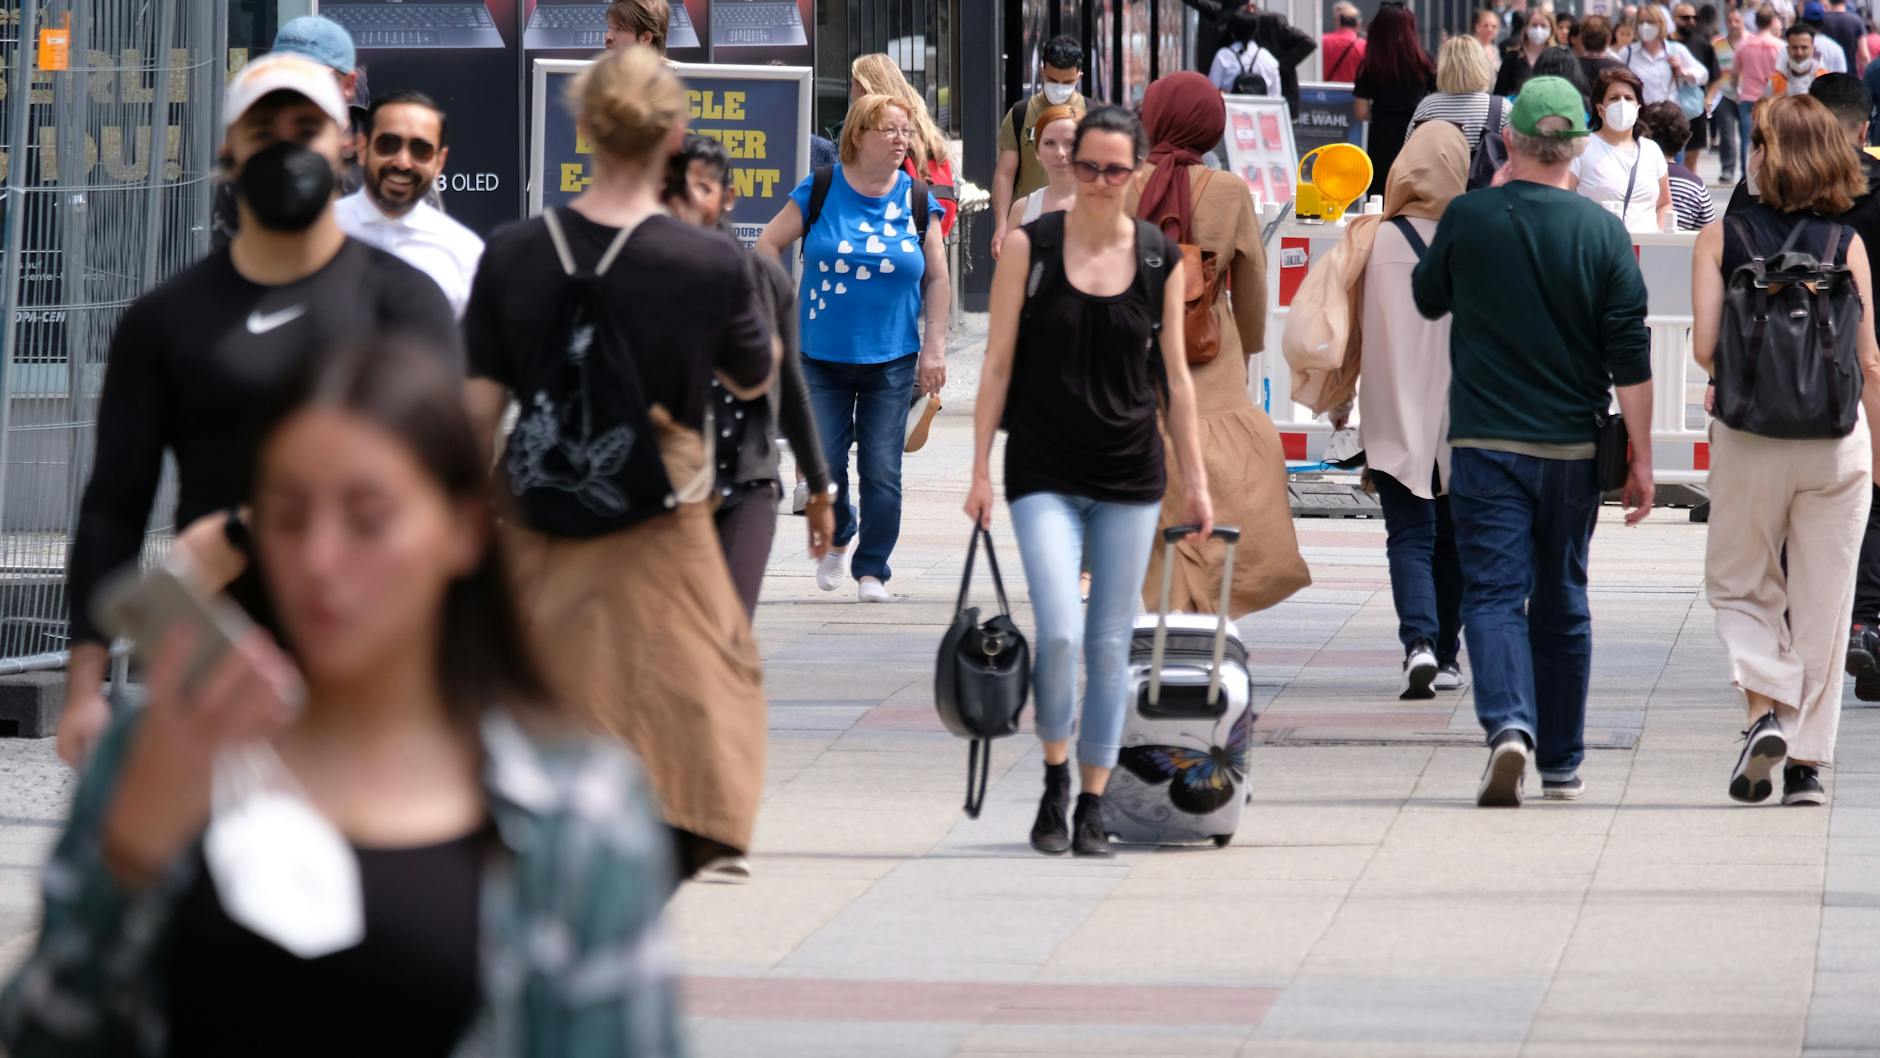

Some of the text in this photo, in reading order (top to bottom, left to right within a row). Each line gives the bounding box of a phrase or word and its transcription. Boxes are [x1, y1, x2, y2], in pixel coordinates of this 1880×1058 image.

[684, 90, 746, 120] CLE
[1311, 114, 1350, 127] WAHL
[438, 173, 499, 191] 3 OLED
[560, 163, 593, 192] E-
[728, 168, 780, 197] NT
[16, 311, 65, 322] OPA-CEN
